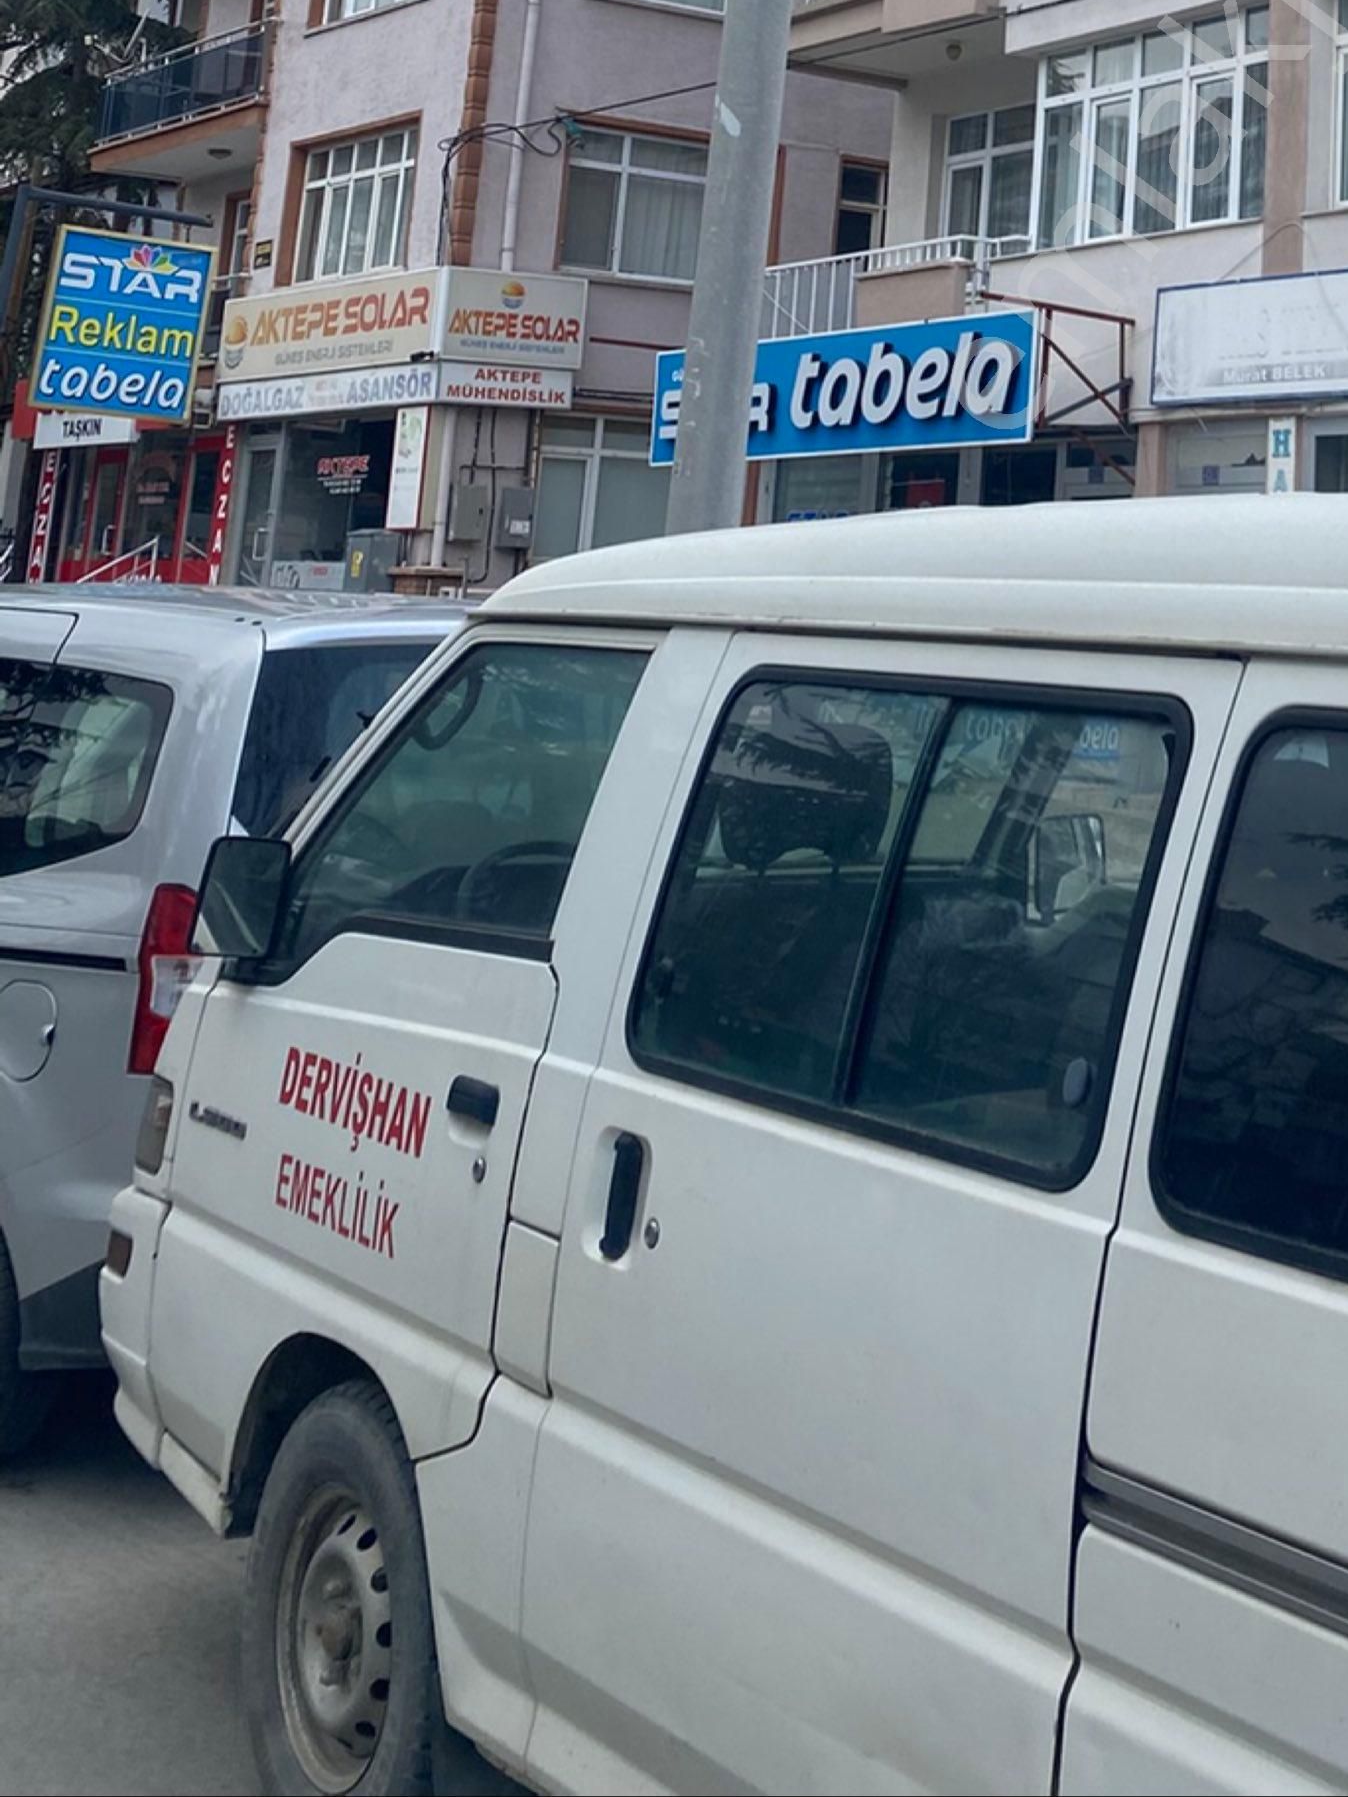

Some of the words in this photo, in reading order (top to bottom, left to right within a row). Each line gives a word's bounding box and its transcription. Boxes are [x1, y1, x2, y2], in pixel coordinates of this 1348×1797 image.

[59, 252, 203, 303] STAR
[50, 304, 195, 357] Reklam
[250, 298, 341, 346] AKTEPE
[341, 285, 430, 335] SOLAR
[448, 308, 519, 339] AKTEPE
[520, 313, 581, 344] SOLAR
[39, 358, 185, 409] tabela
[220, 385, 305, 416] DOĞALGAZ
[348, 368, 432, 403] ASANSÖR
[447, 383, 566, 403] MÜHENDİSLİK
[474, 367, 542, 384] AKTEPE
[789, 330, 1015, 431] tabela
[1272, 363, 1326, 381] BELEK
[62, 418, 103, 441] TAŞKIN
[279, 1046, 432, 1159] DERVİŞHAN
[275, 1153, 399, 1259] EMEKLİLİK
